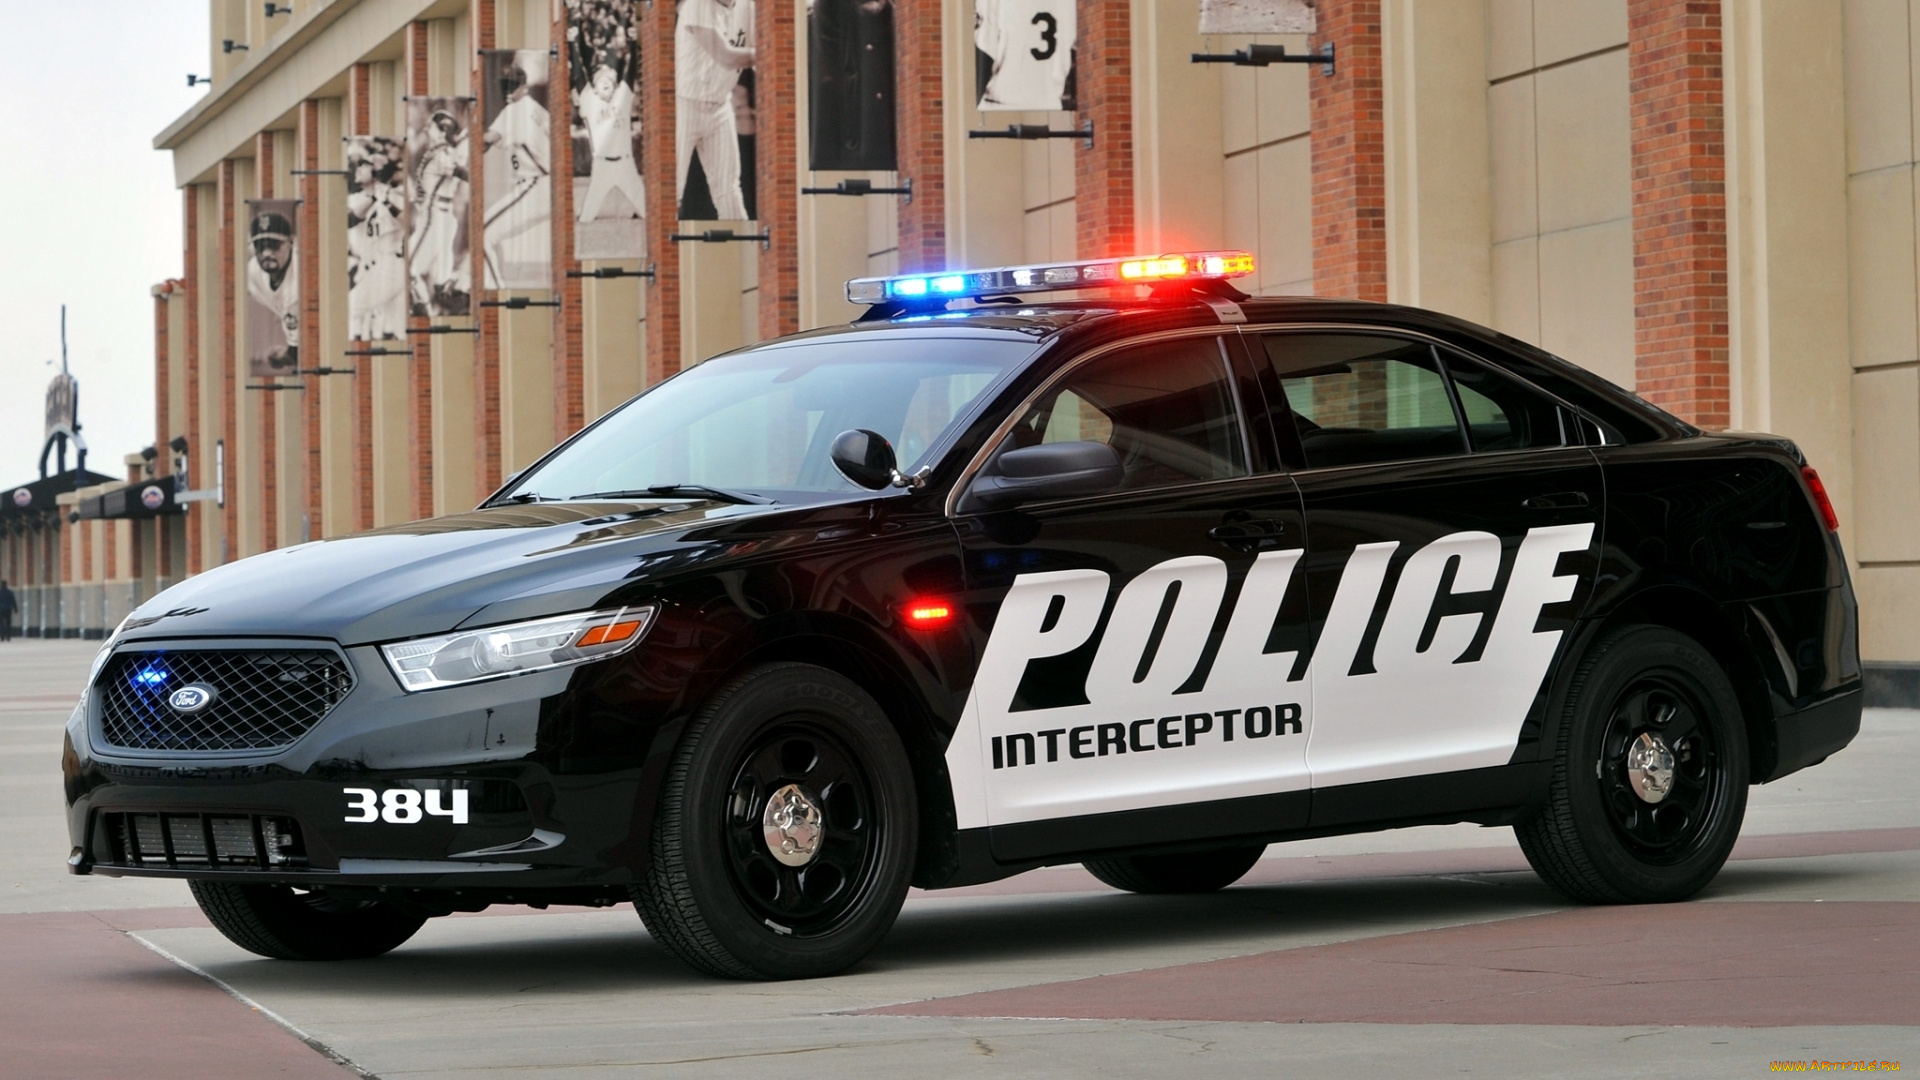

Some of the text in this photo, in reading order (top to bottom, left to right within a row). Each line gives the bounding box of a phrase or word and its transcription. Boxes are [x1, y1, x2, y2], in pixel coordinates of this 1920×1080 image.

[1030, 12, 1057, 61] 3
[511, 154, 520, 170] 6
[966, 522, 1596, 713] POLICE
[175, 691, 198, 706] Ford
[991, 702, 1303, 770] INTERCEPTOR
[343, 787, 469, 825] 384
